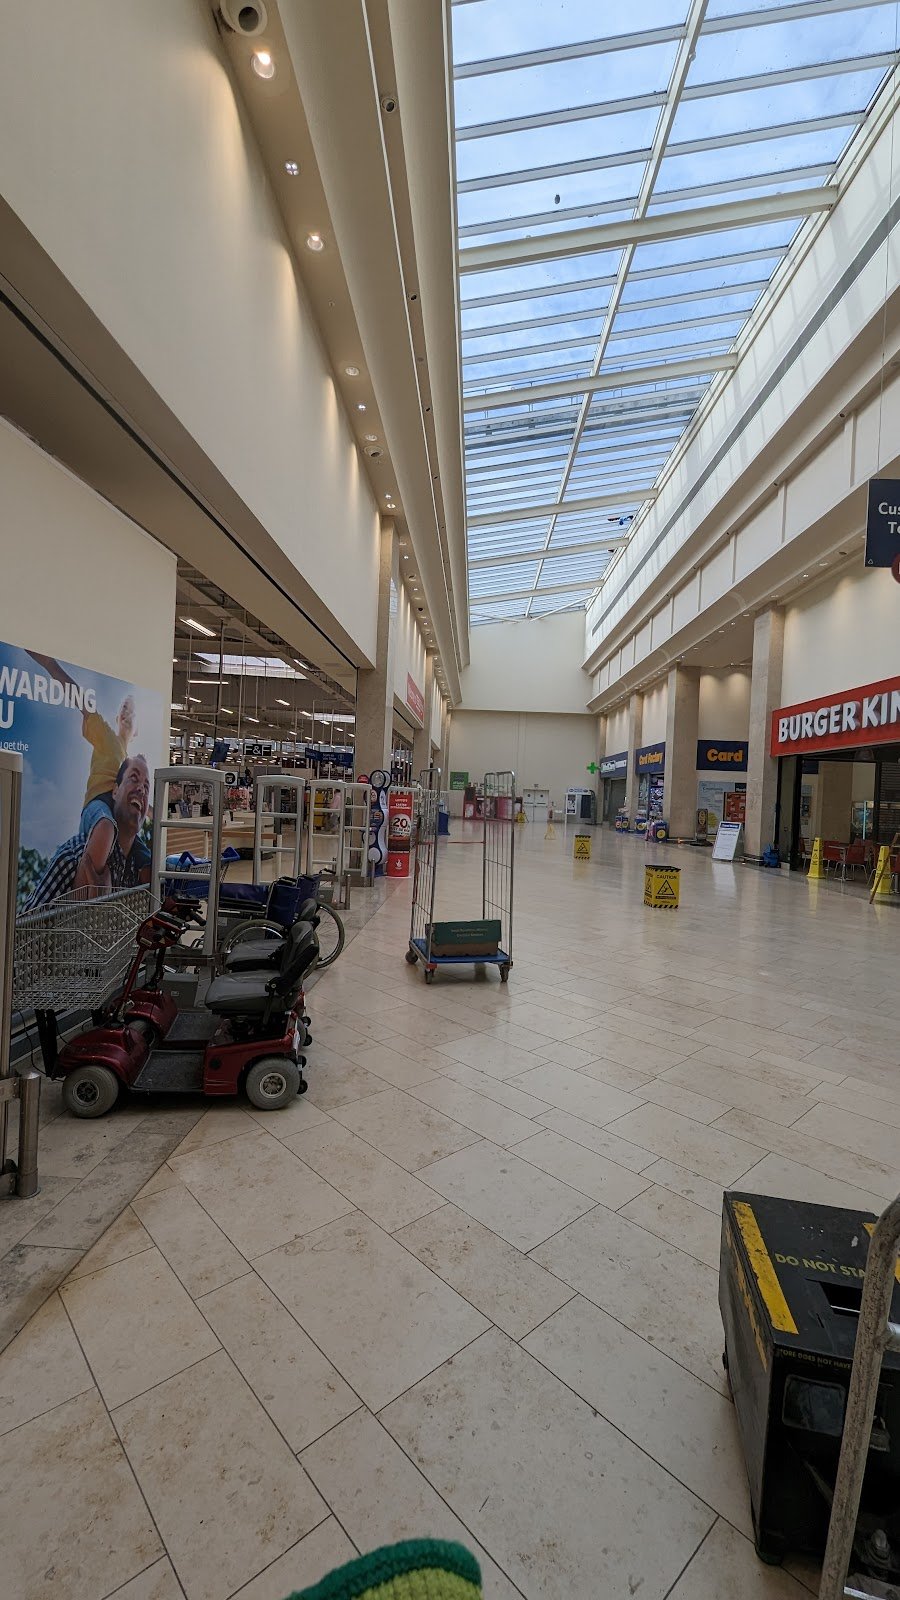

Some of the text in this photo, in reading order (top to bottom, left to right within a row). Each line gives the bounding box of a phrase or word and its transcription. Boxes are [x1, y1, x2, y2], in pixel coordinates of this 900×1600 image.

[778, 701, 860, 743] BURGER
[17, 740, 29, 752] the
[243, 743, 271, 756] F&F
[706, 748, 744, 763] Card
[774, 1253, 799, 1266] DO
[802, 1258, 837, 1274] NOT
